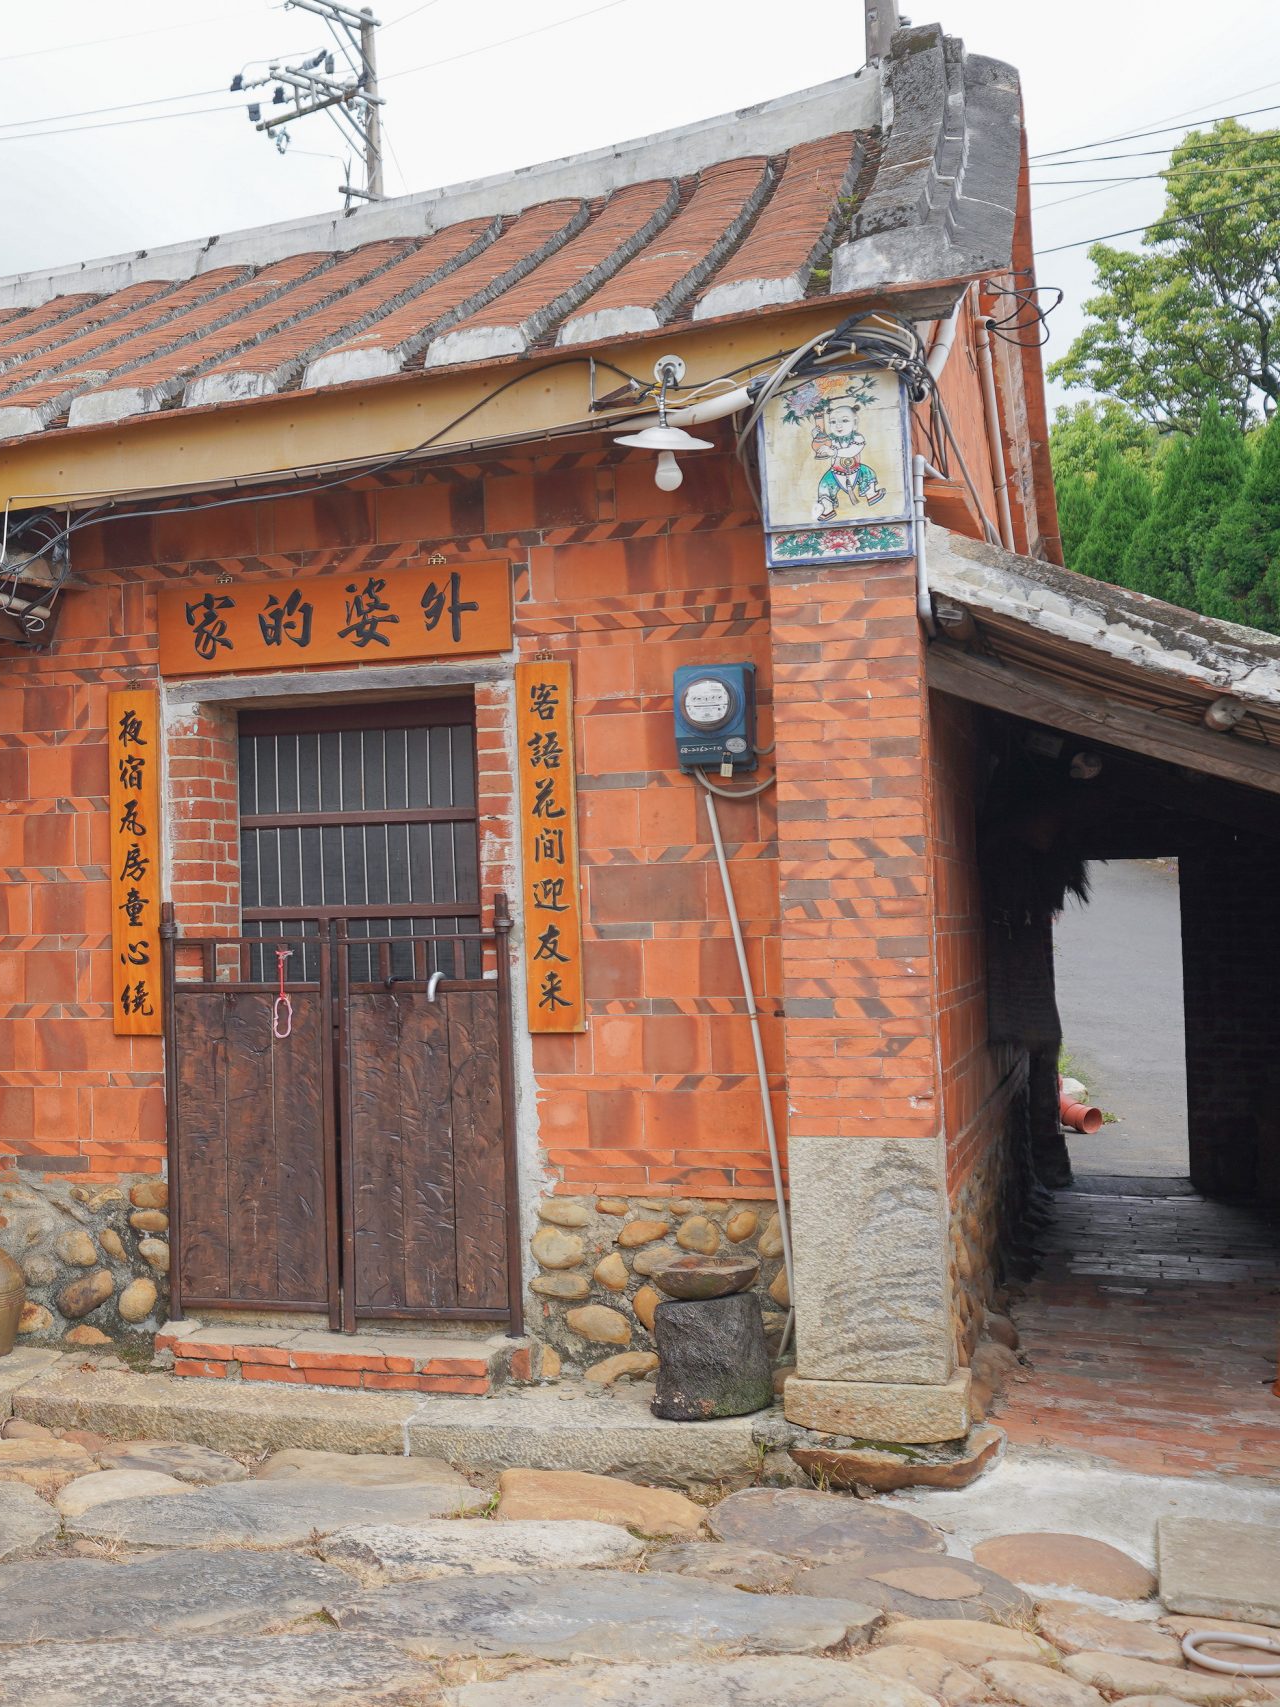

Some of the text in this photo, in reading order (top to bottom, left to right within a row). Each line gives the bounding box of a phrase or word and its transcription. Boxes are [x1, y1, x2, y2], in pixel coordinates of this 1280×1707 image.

[185, 571, 479, 661] 外婆的家
[118, 709, 154, 1017] 夜宿瓦房童心繞
